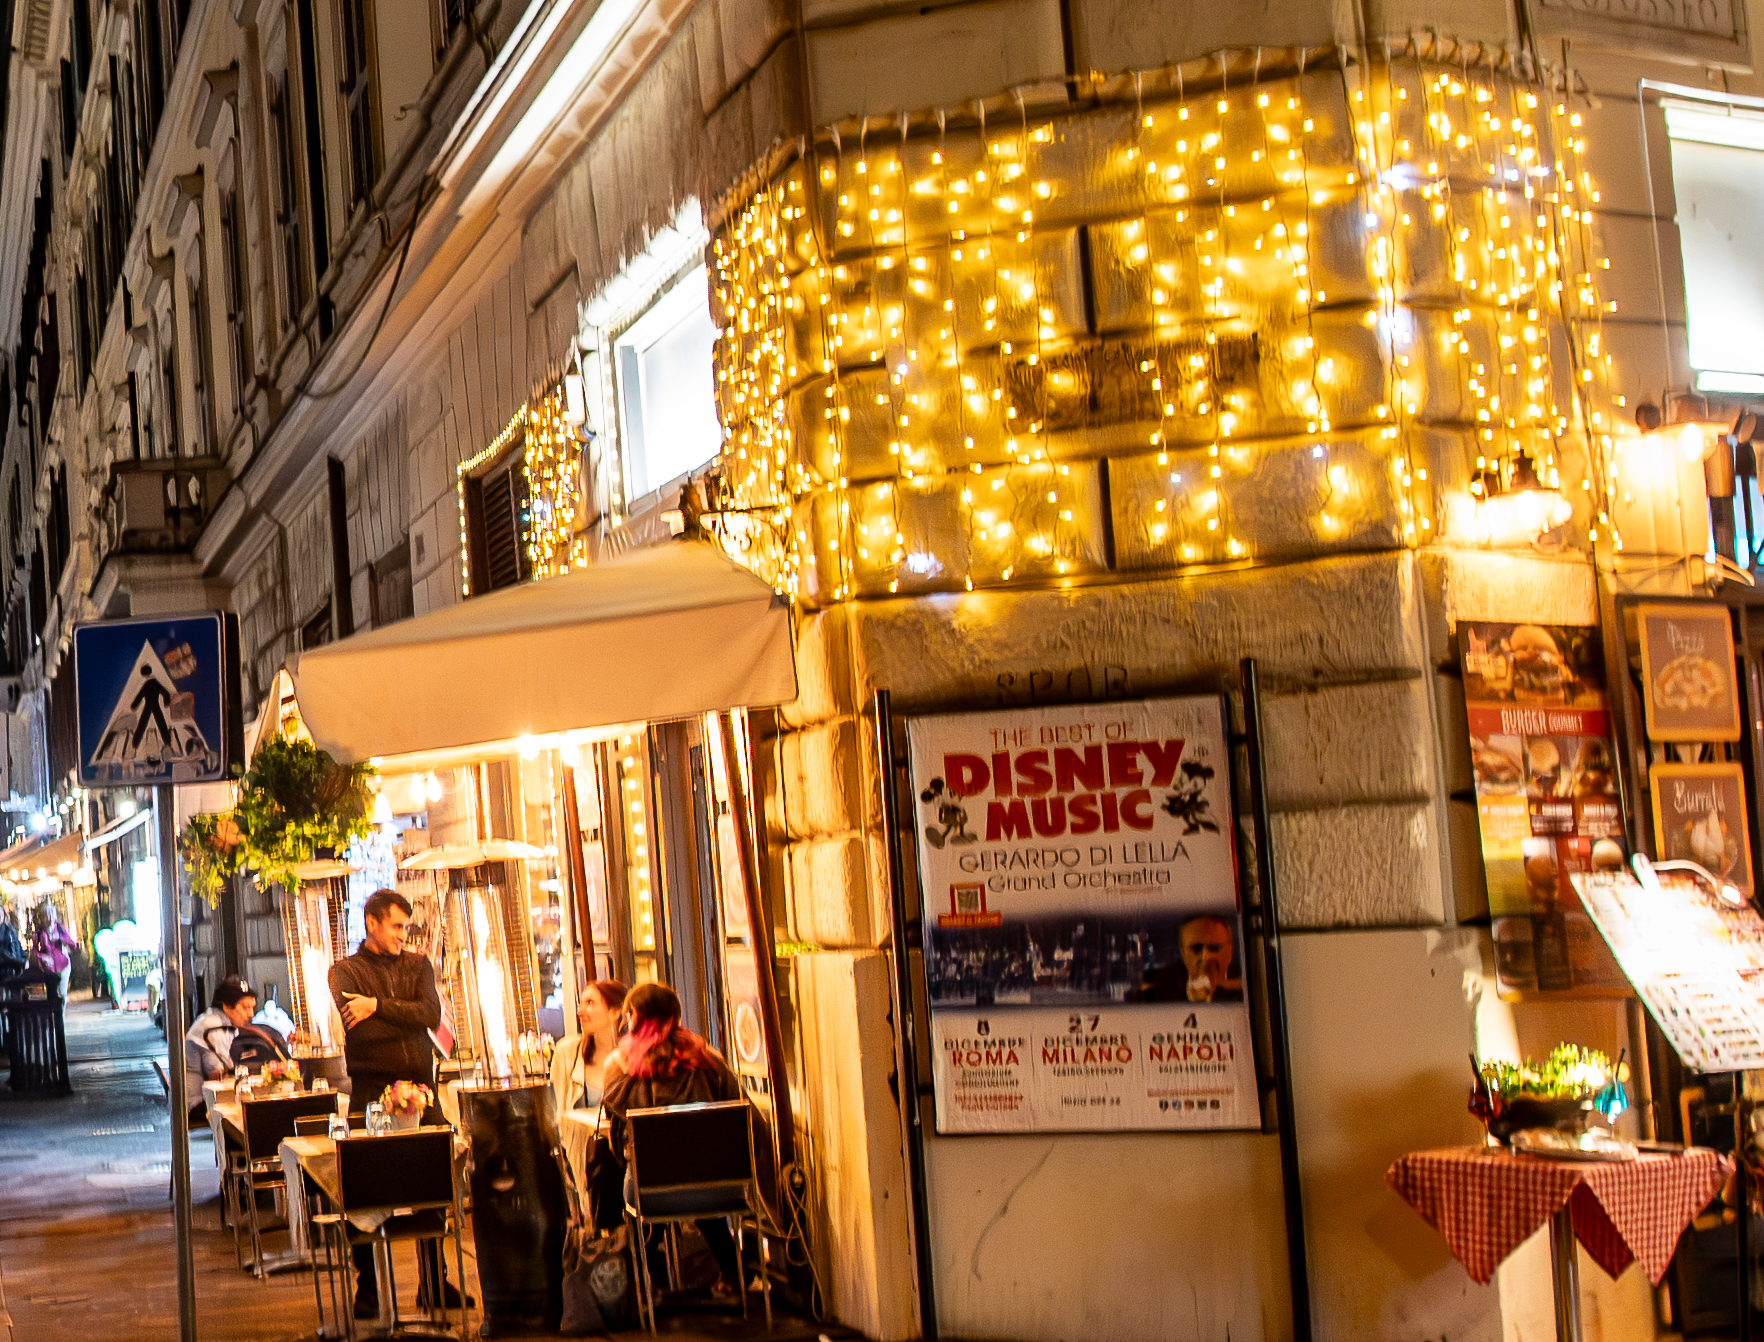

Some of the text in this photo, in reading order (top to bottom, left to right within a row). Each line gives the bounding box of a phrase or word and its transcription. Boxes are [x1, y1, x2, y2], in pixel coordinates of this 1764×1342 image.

[990, 727, 1030, 750] THE
[943, 739, 1186, 798] DISNEY
[985, 789, 1154, 842] MUSIC
[959, 840, 1191, 873] GERARDO DI LELLA
[987, 870, 1056, 893] Grand
[951, 1042, 1235, 1068] ROMA MILANO NAPOLI
